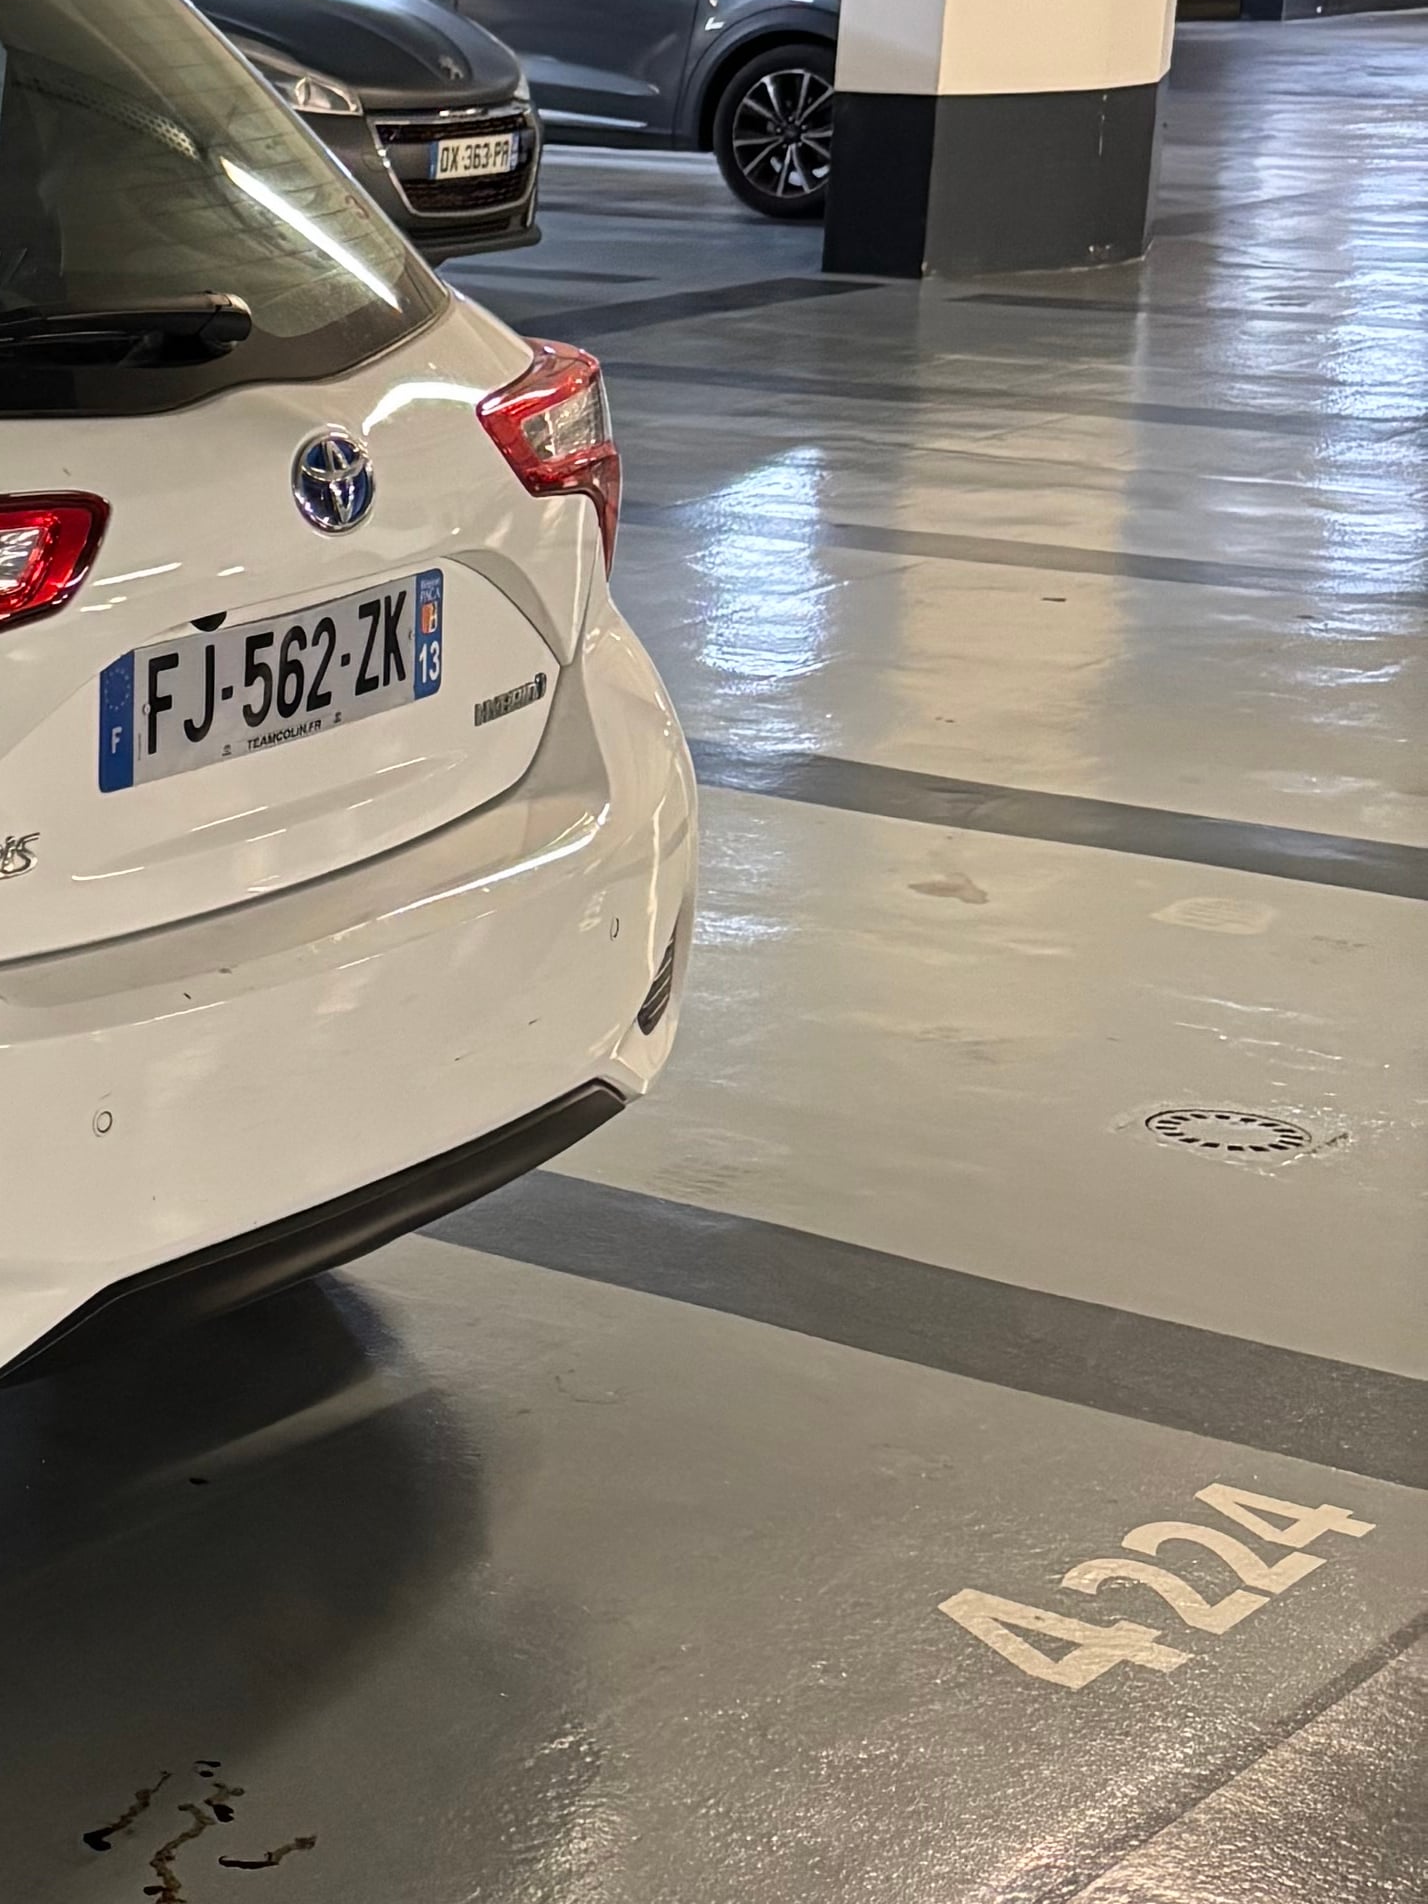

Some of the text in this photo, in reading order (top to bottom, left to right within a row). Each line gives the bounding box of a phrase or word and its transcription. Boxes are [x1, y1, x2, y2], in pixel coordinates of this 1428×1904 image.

[147, 590, 408, 756] FJ-562-ZK
[419, 640, 441, 684] 13
[110, 725, 123, 754] F
[937, 1482, 1377, 1691] 4224
